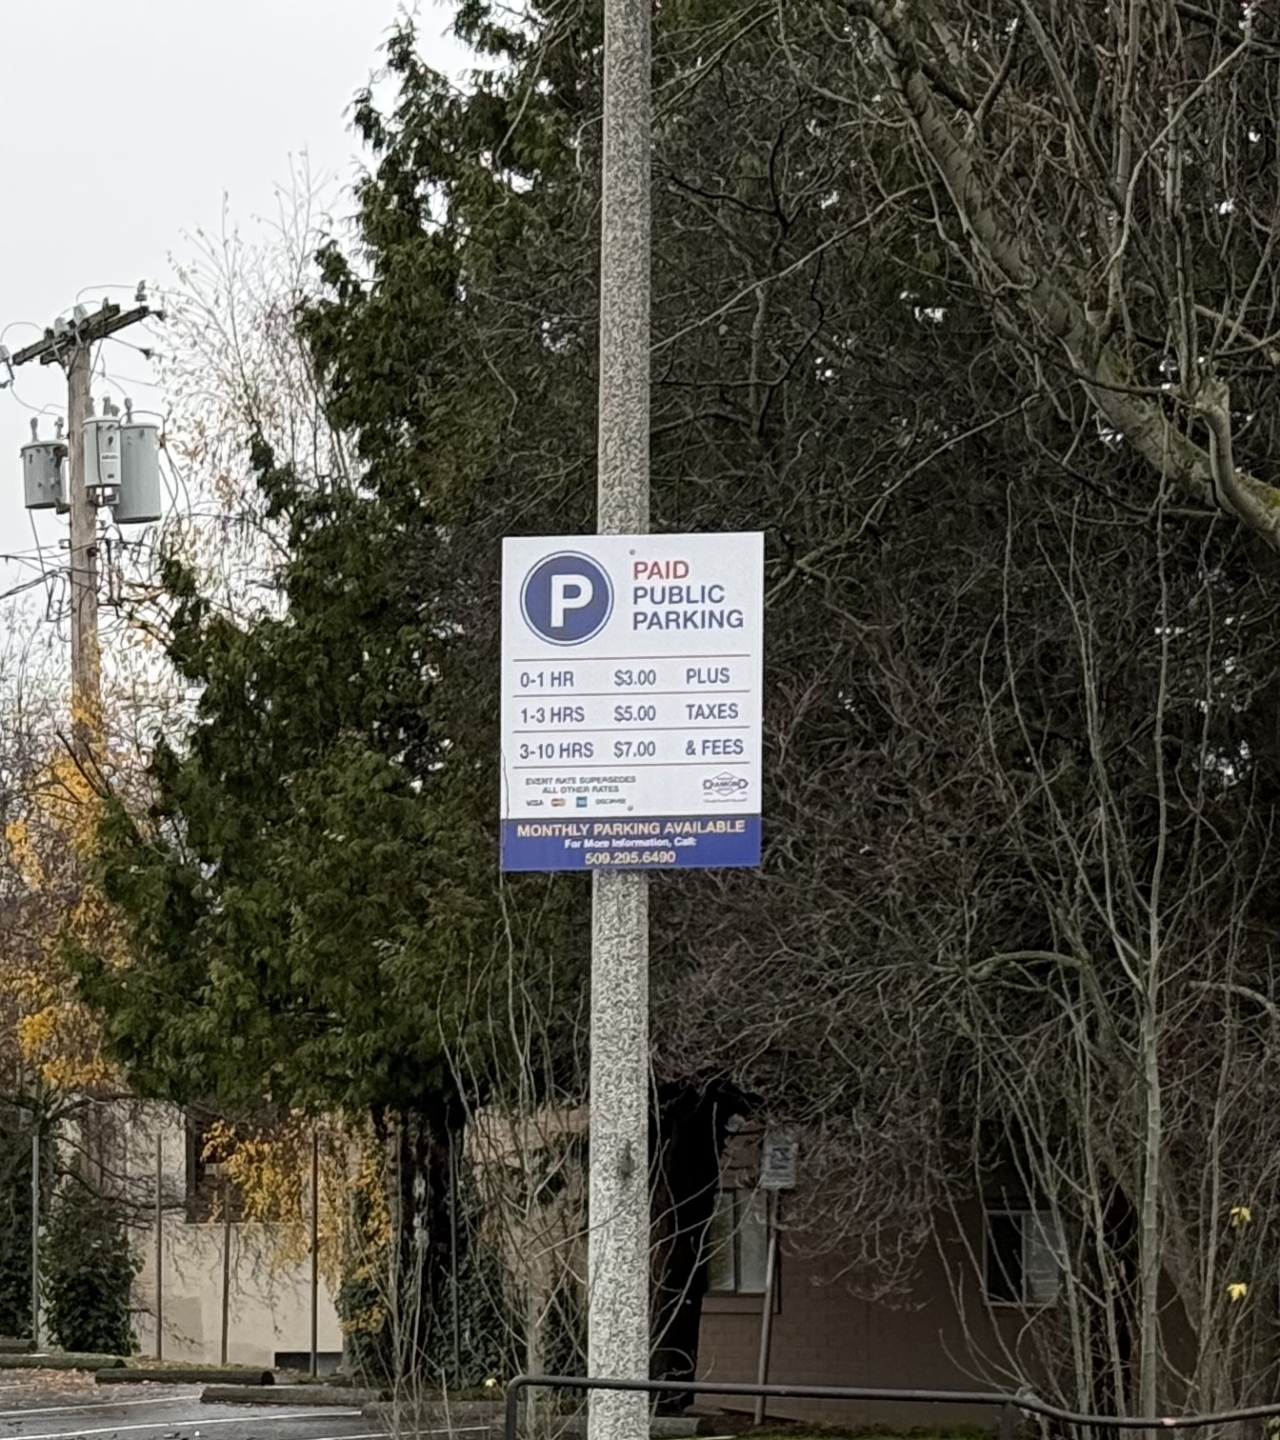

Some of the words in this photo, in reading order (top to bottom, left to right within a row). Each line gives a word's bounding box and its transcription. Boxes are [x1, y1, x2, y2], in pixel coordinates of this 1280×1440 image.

[633, 560, 690, 580] PAID
[550, 574, 594, 628] P
[632, 585, 726, 606] PUBLIC
[632, 609, 744, 631] PARKING
[520, 671, 544, 688] 0-1
[550, 670, 574, 687] HR
[614, 669, 657, 687] $3.00
[686, 667, 730, 684] PLUS
[520, 707, 546, 724] 1-3
[550, 706, 585, 723] HRS
[613, 704, 656, 722] $5.00
[686, 703, 739, 720] TAXES
[519, 743, 555, 760] 3-10
[559, 742, 594, 759] HRS
[613, 740, 656, 759] $7.00
[685, 739, 697, 756] &
[702, 739, 744, 756] FEES
[517, 822, 588, 837] MONTHLY
[593, 821, 660, 836] PARKING
[663, 820, 746, 835] AVAILABLE
[564, 839, 581, 849] For
[583, 839, 609, 848] More
